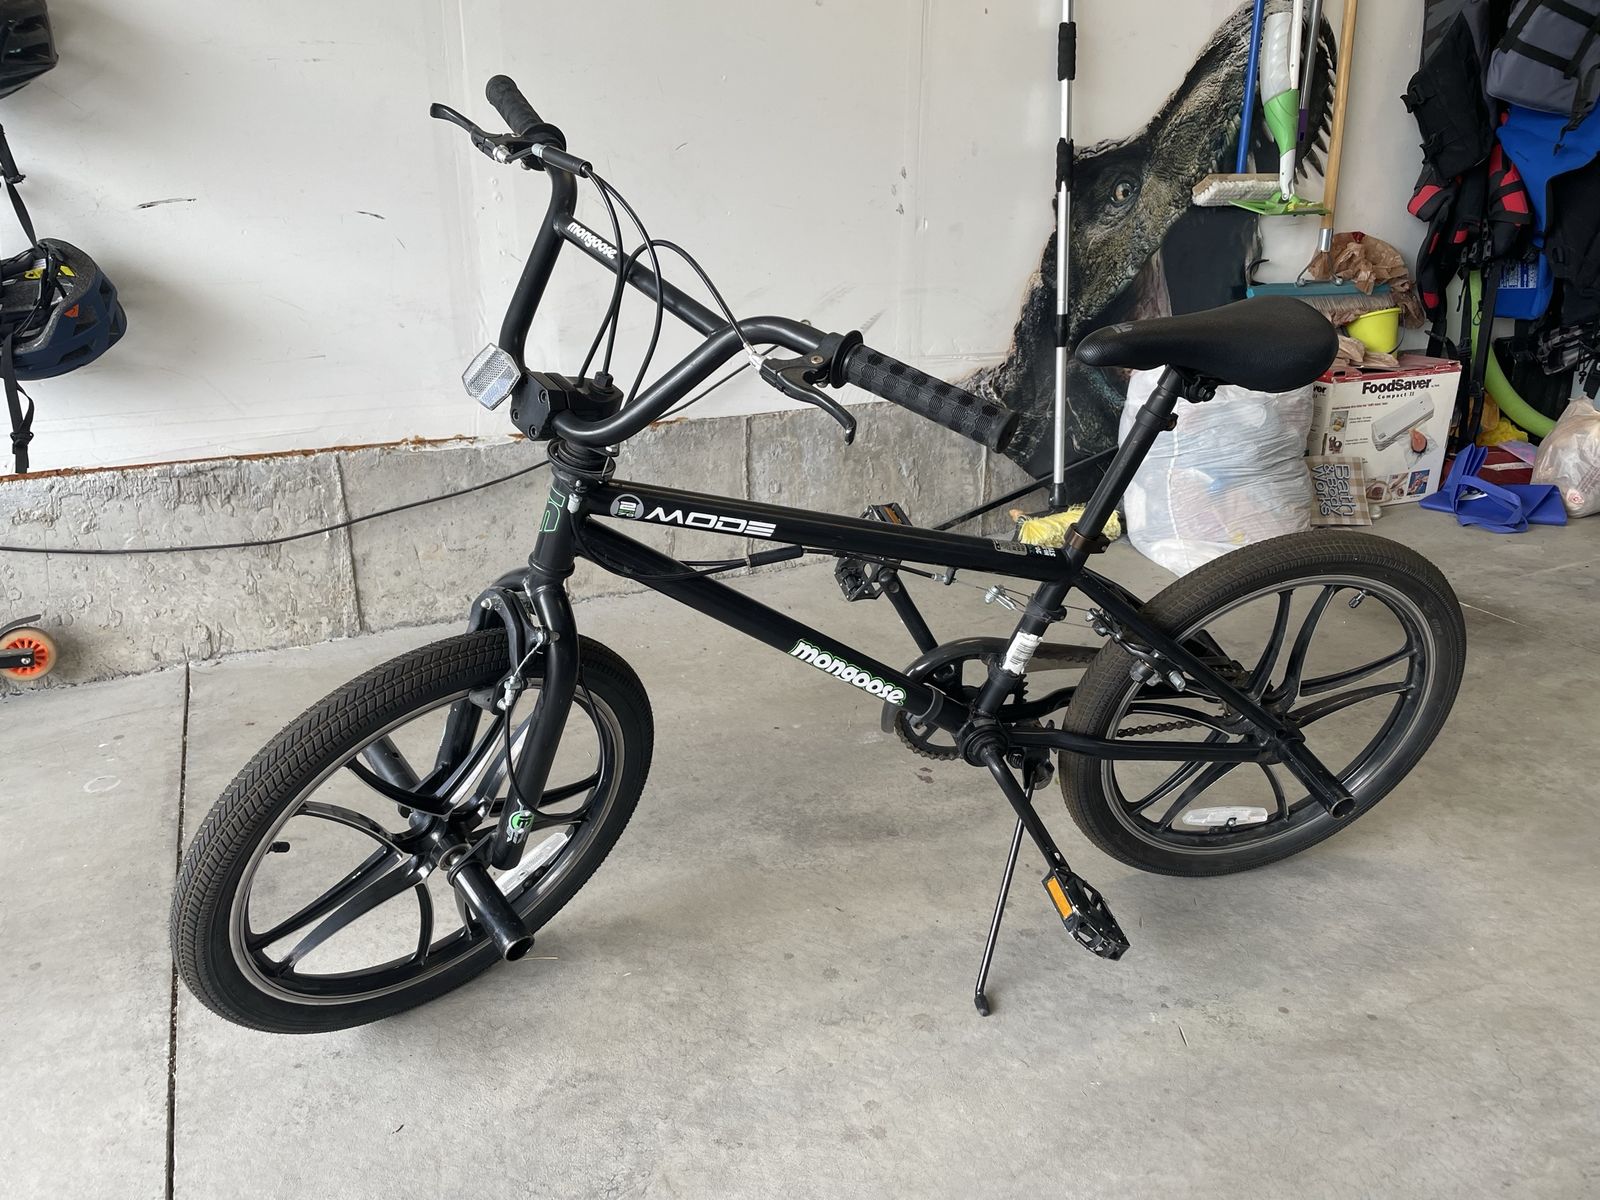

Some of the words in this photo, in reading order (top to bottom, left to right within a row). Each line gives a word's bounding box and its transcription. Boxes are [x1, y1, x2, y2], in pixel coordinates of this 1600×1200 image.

[567, 222, 617, 259] mongoose
[1362, 378, 1432, 394] FoodSaver
[1377, 392, 1407, 400] Compact
[1323, 463, 1335, 475] &
[1311, 464, 1331, 516] Works
[1326, 477, 1343, 517] Body
[1334, 464, 1356, 517] Bath
[645, 506, 777, 538] MODE
[789, 640, 905, 704] mongoose
